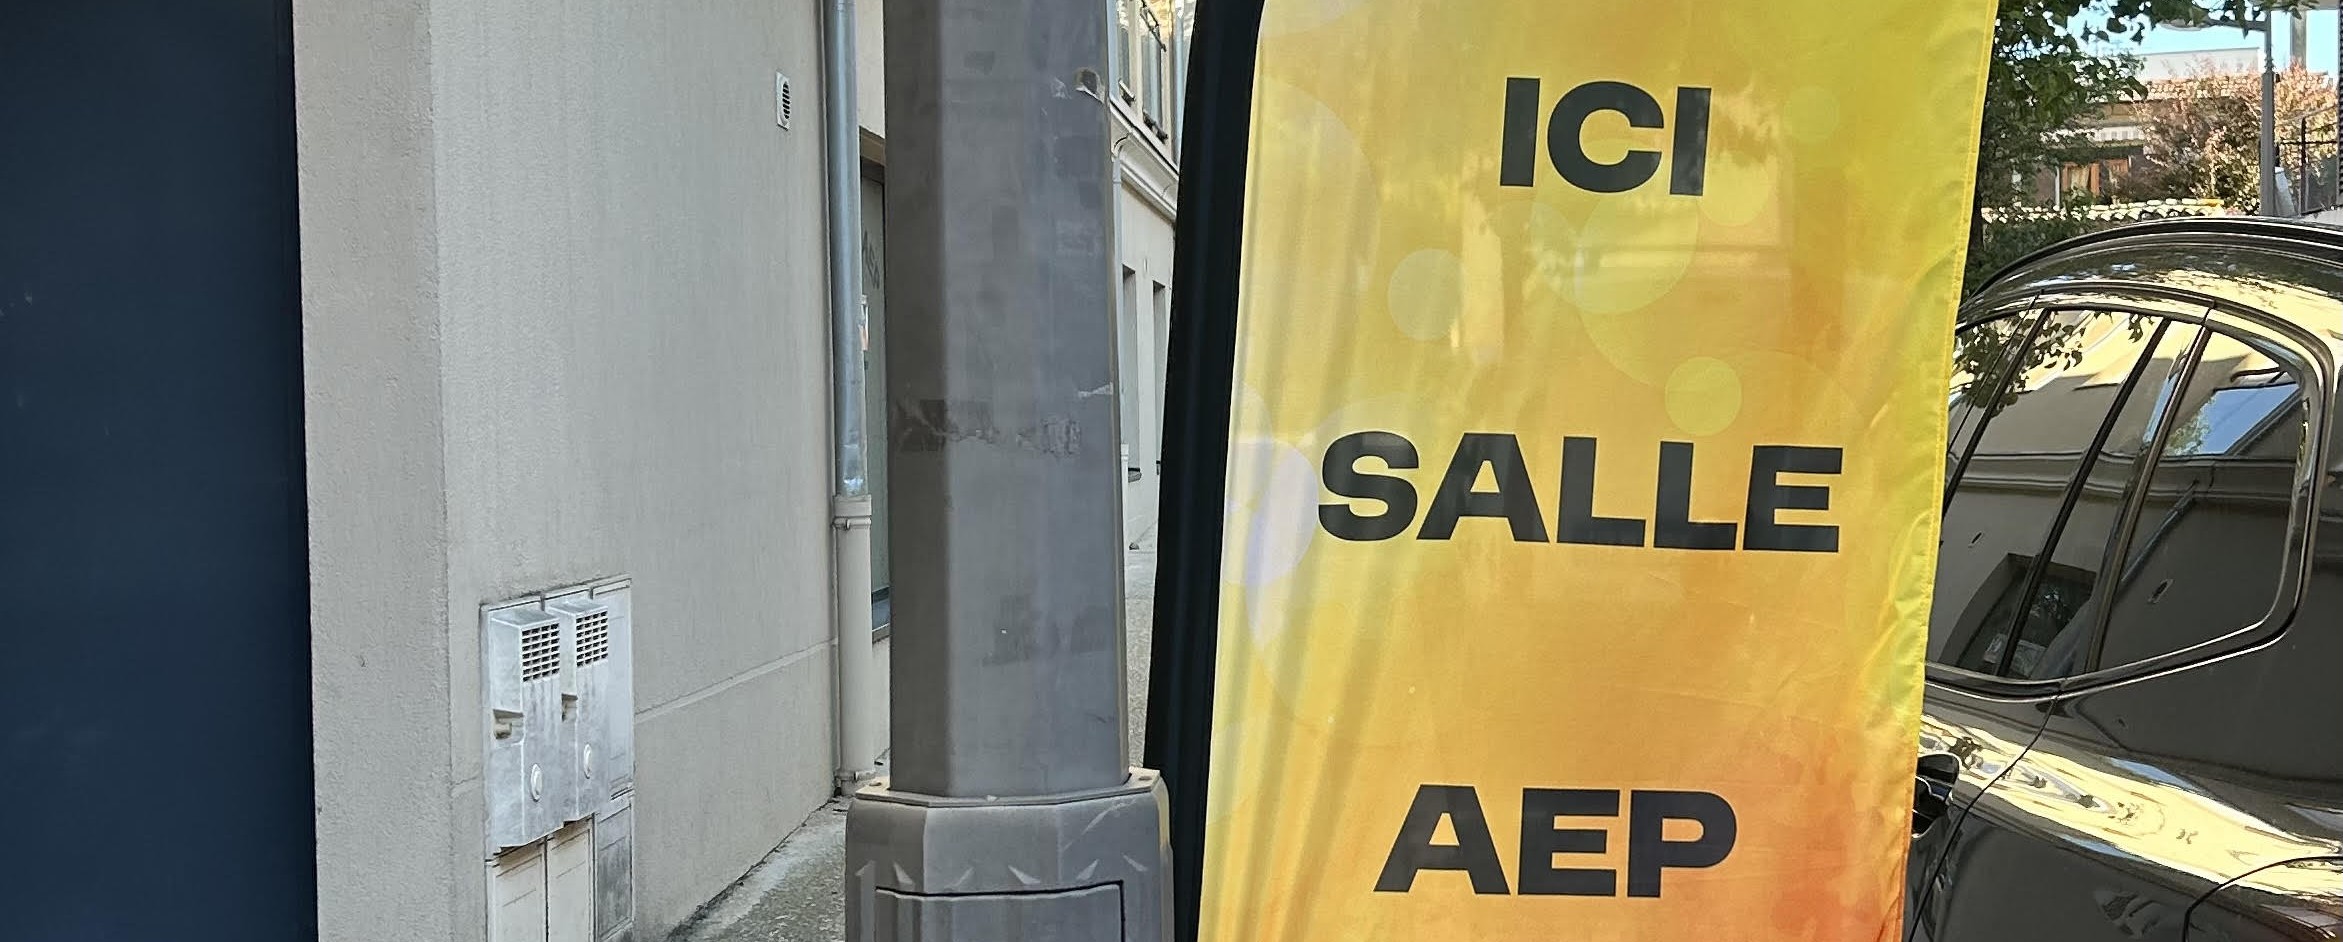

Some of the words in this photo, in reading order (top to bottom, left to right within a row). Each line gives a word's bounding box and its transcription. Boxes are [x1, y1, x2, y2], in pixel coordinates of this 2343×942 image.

[1500, 77, 1712, 197] ICI
[1318, 431, 1843, 553] SALLE
[1373, 784, 1737, 898] AEP
